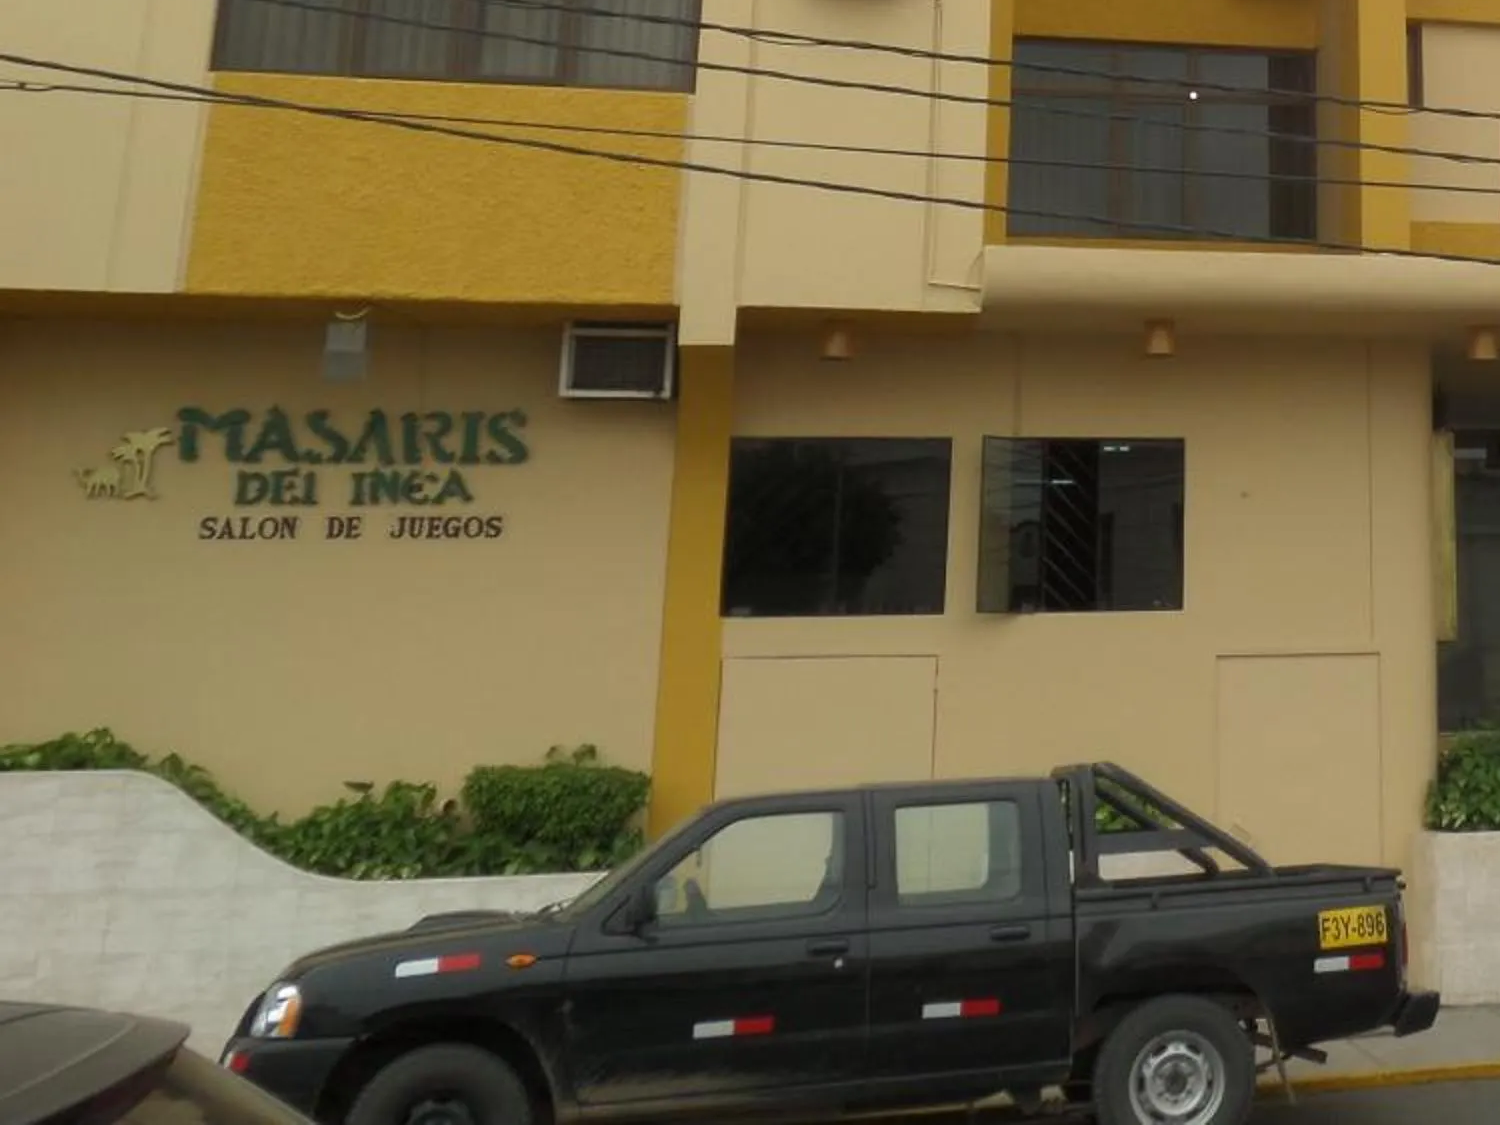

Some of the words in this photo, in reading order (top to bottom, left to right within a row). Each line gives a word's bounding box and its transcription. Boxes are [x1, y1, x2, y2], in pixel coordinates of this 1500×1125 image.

[177, 405, 530, 465] MASARIS
[349, 469, 474, 506] INCA
[199, 516, 297, 540] SALON
[327, 516, 362, 539] DE
[390, 515, 503, 539] JUEGOS
[1321, 911, 1385, 941] F3Y-896
